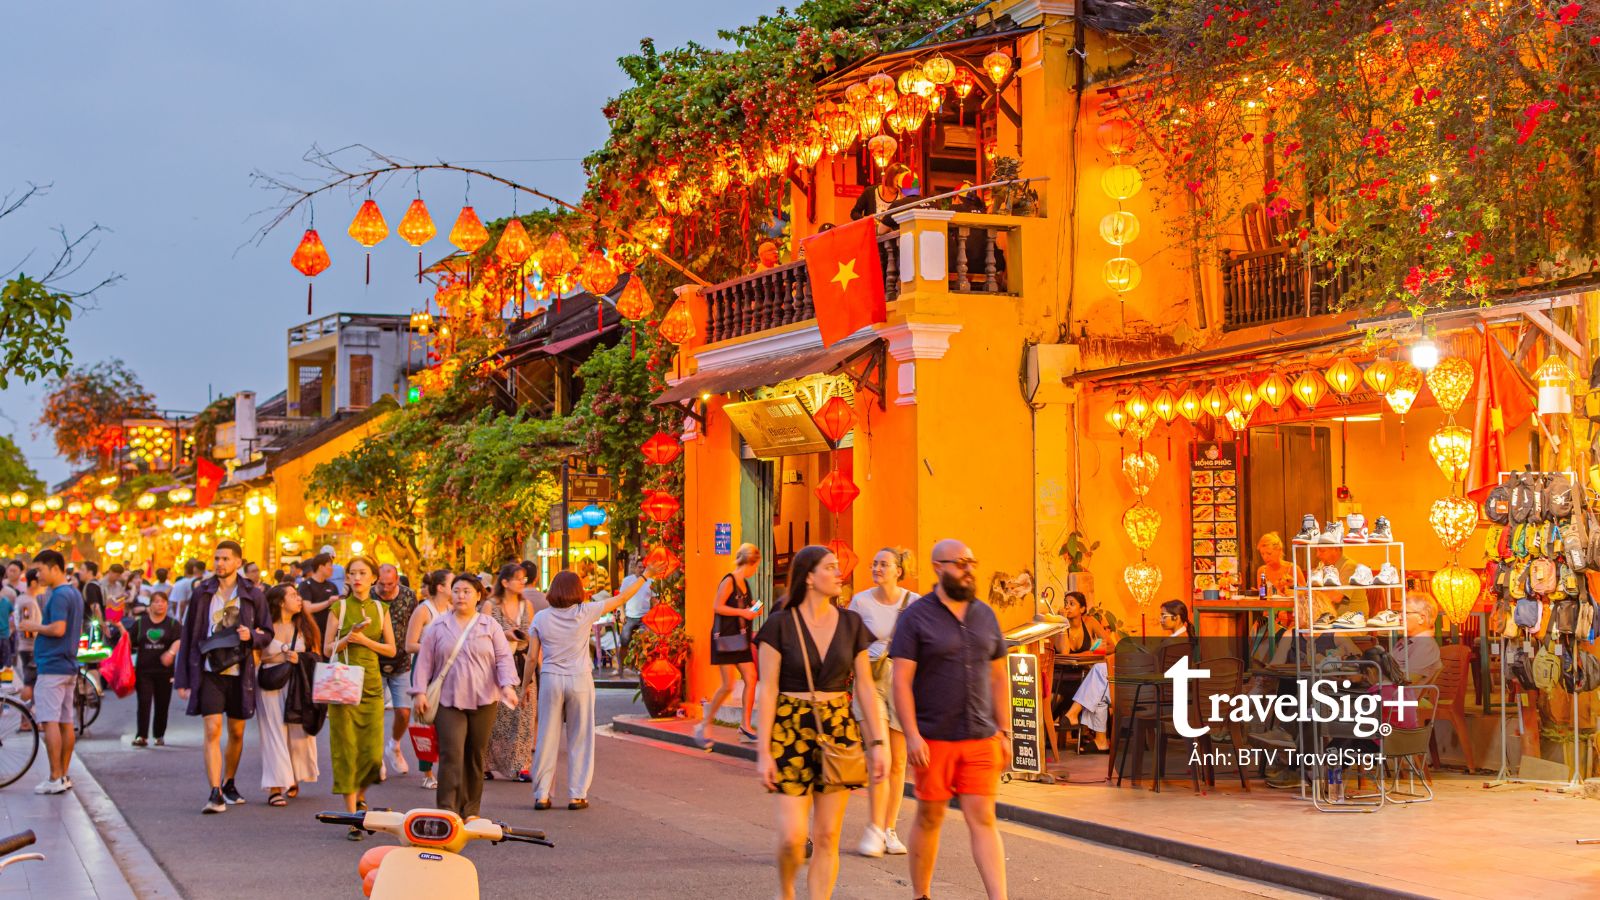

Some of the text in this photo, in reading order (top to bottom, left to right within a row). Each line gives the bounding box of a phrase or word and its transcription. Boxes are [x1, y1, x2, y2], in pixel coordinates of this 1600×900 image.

[1013, 698, 1035, 708] BEST PIZZA
[1013, 719, 1035, 728] LOCAL FOOD
[1019, 746, 1033, 757] BBQ
[1016, 757, 1036, 766] SEAFOOD
